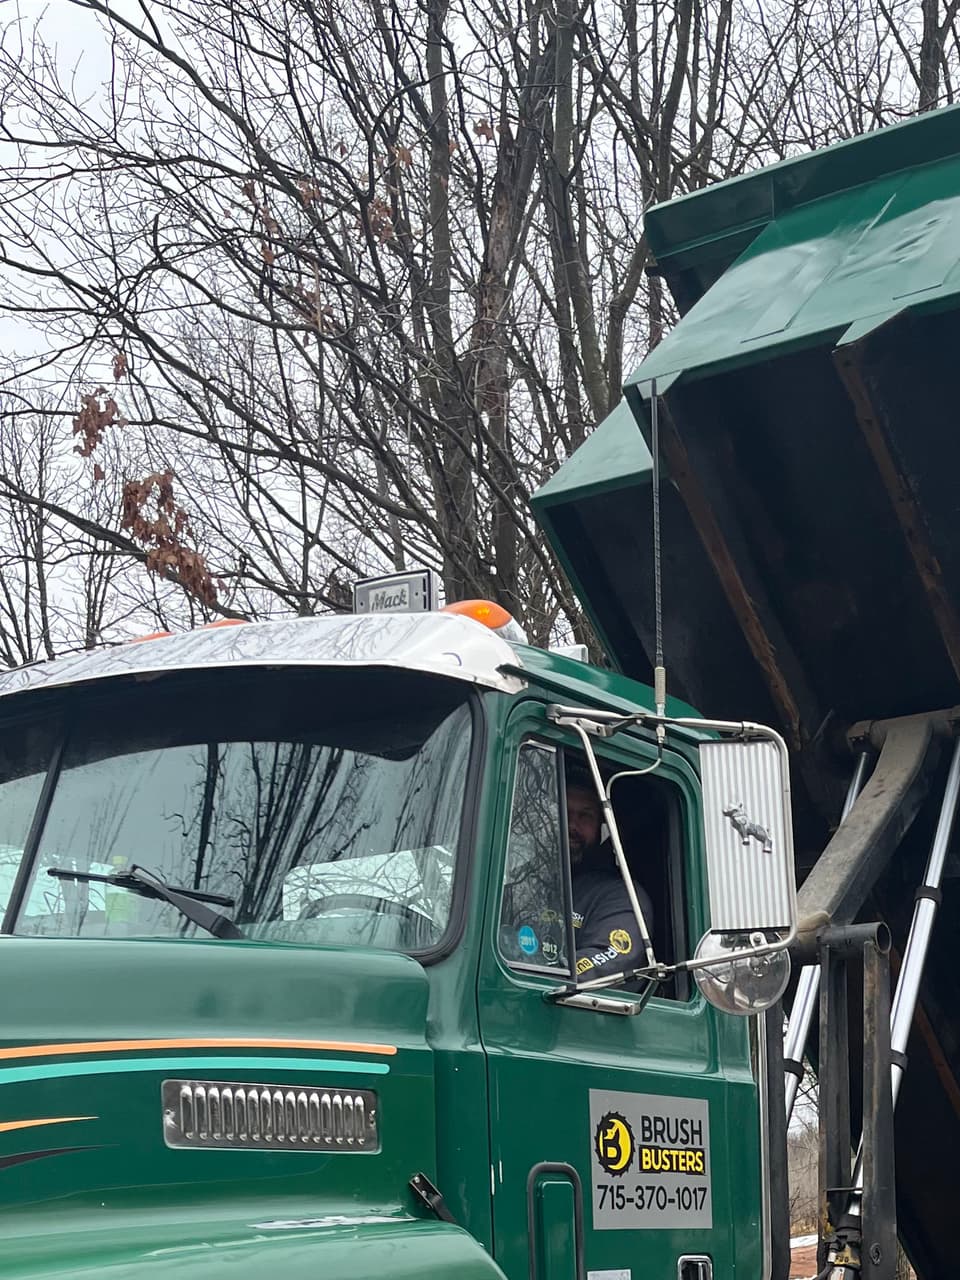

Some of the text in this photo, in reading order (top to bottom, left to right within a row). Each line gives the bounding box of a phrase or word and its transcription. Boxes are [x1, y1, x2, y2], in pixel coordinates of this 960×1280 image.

[371, 588, 407, 612] Mack
[641, 1115, 703, 1146] BRUSH
[641, 1148, 704, 1172] BUSTERS
[596, 1184, 708, 1211] 715-370-1017
